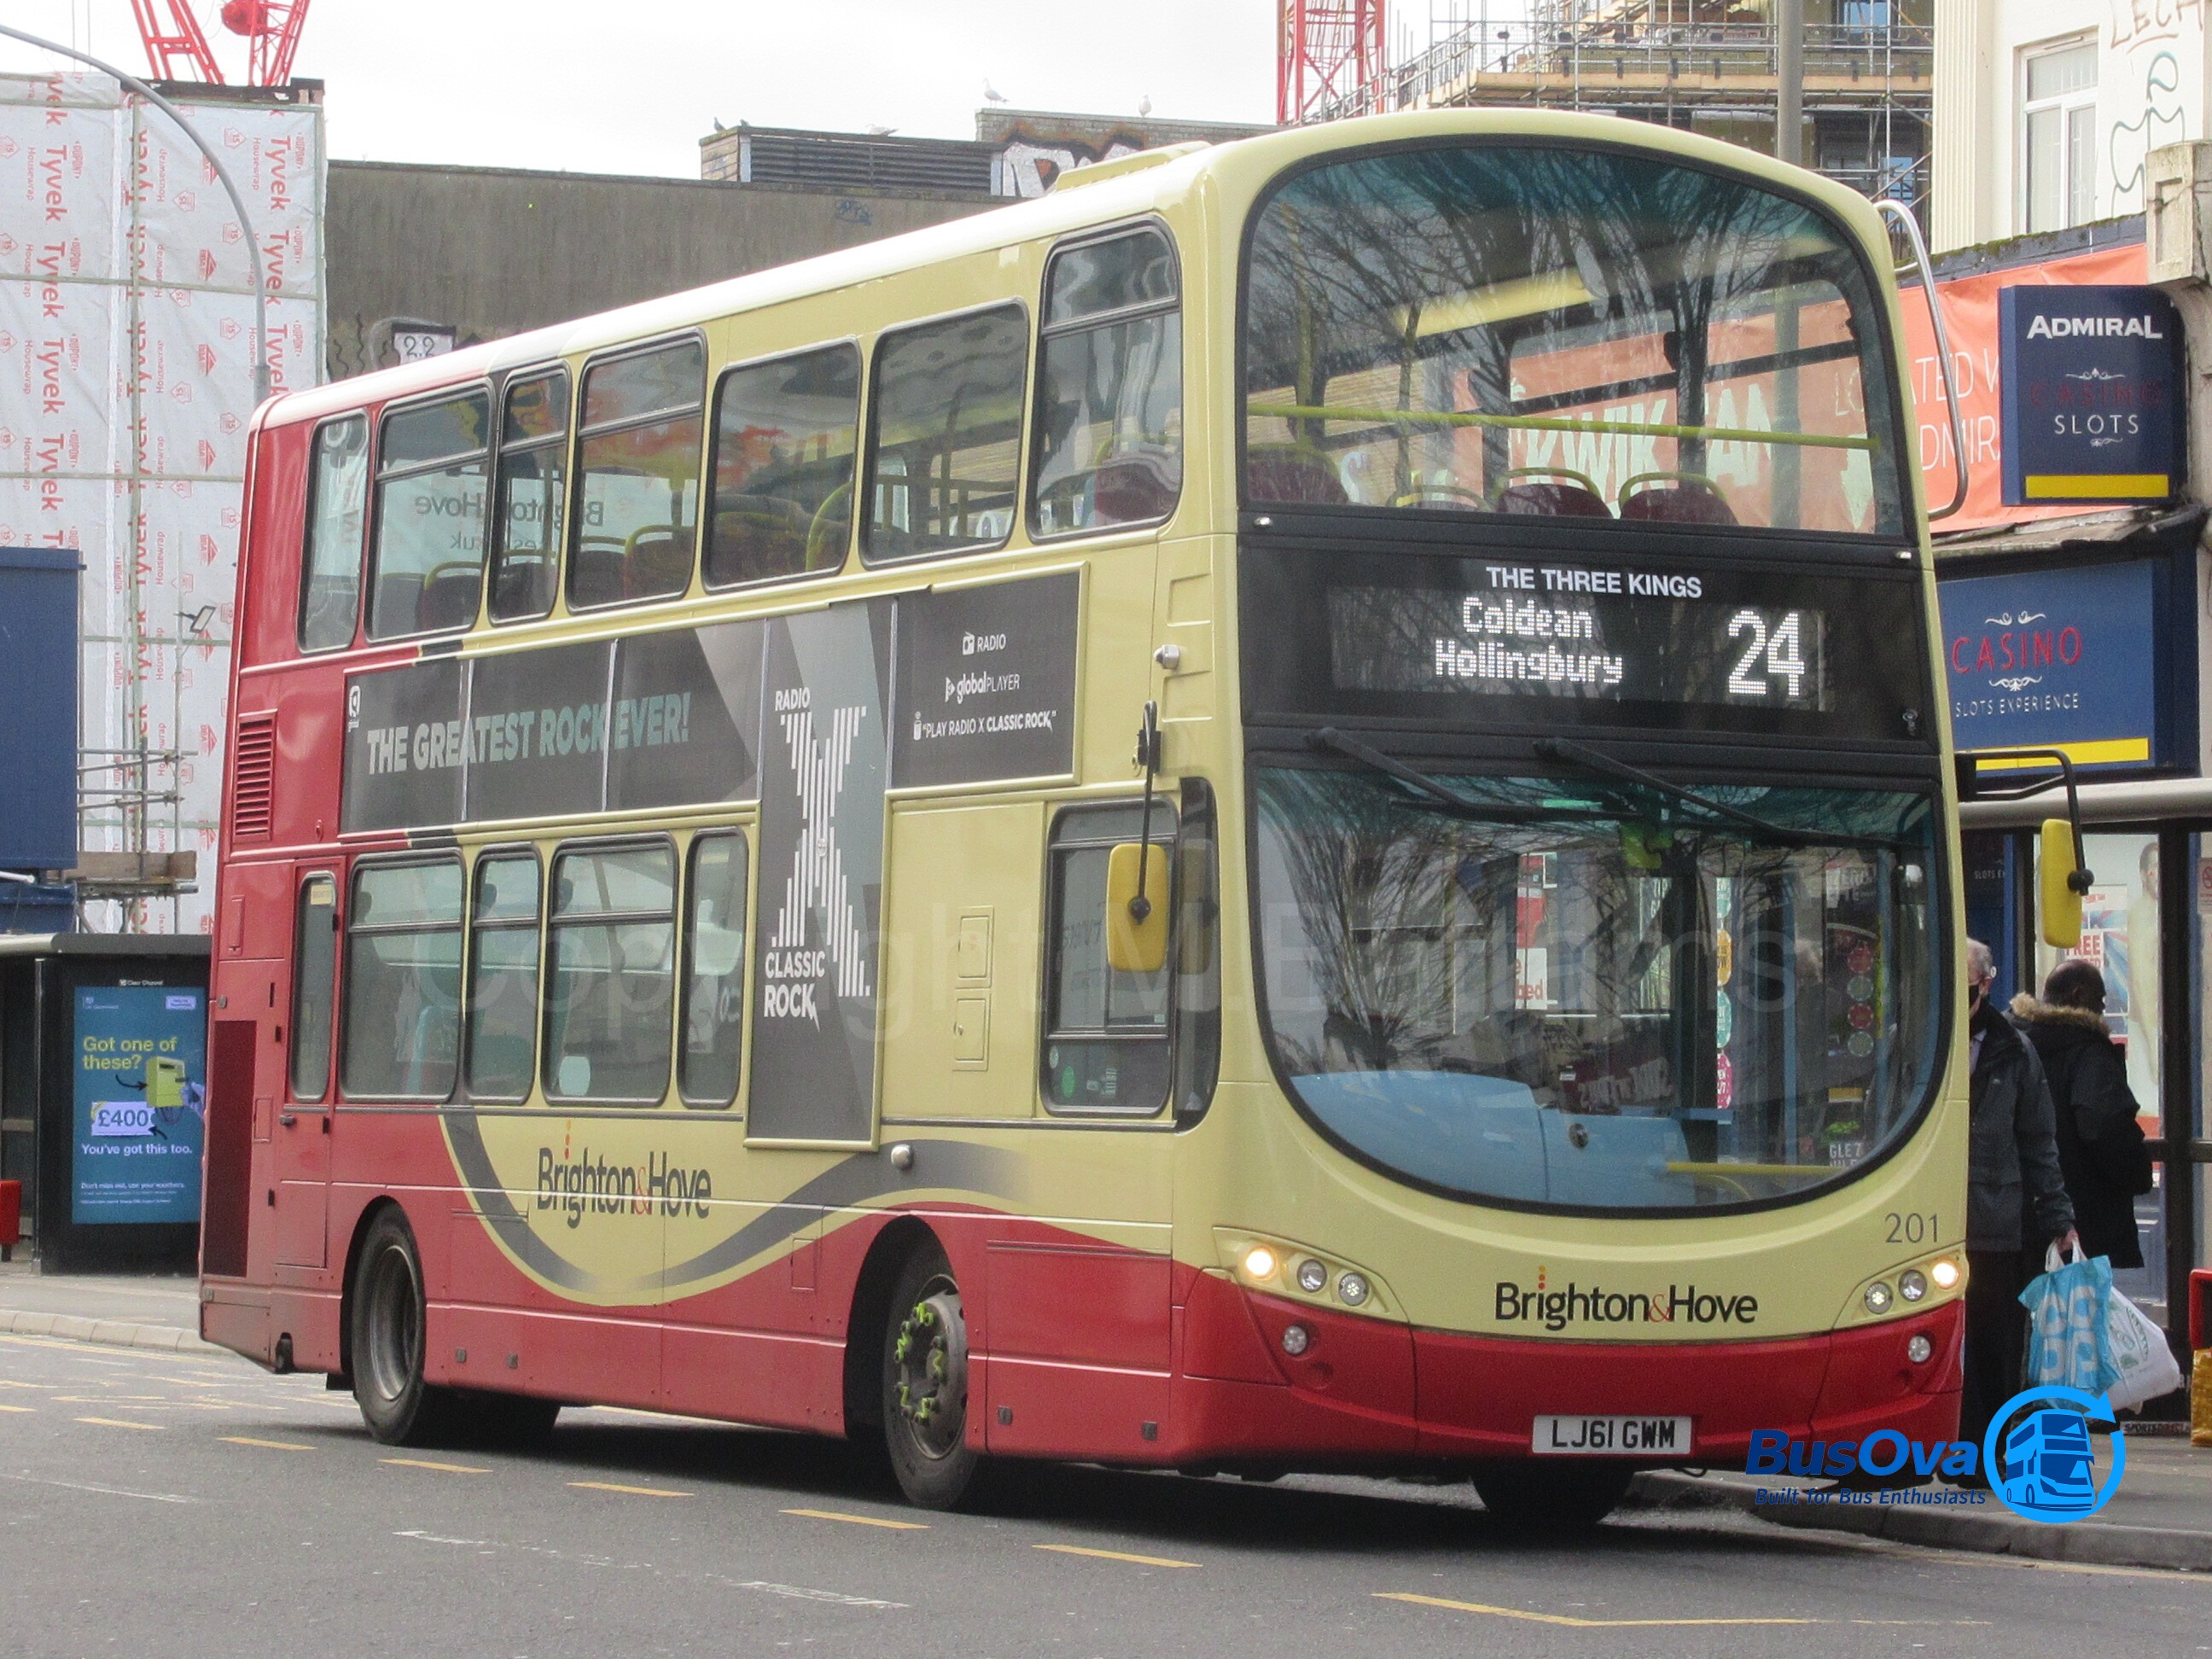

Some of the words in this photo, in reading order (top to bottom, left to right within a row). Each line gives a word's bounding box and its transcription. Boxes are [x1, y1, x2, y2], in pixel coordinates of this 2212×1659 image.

[26, 147, 36, 201] Housewrap
[252, 137, 261, 190] Housewrap
[265, 136, 292, 212] Tyvek
[40, 145, 68, 222] Tyvek
[2026, 315, 2163, 340] ADMIRAL
[23, 340, 33, 395] Housewrap
[37, 337, 66, 414] Tyvek
[2029, 384, 2163, 408] CASINO
[2054, 415, 2139, 435] SLOTS
[155, 531, 166, 586] Housewrap
[1486, 566, 1535, 590] THE
[1541, 569, 1621, 594] THREE
[1628, 573, 1703, 598] KINGS
[1462, 597, 1592, 638] Coldean
[976, 633, 1006, 653] RADIO
[1728, 610, 1805, 696] 24
[1952, 627, 2082, 673] CASINO
[1435, 639, 1622, 685] Hollingbury
[775, 687, 811, 713] RADIO
[1955, 698, 1994, 718] SLOTS
[2000, 692, 2080, 714] EXPERIENCE
[367, 726, 408, 775] THE
[413, 711, 535, 771] GREATEST
[539, 705, 609, 757] ROCK
[614, 691, 692, 749] EVER!
[949, 718, 976, 736] RADIO
[978, 717, 985, 733] X
[986, 713, 1024, 732] CLASSIC
[765, 951, 825, 980] CLASSIC
[764, 983, 820, 1028] ROCK
[83, 1036, 115, 1052] Got
[120, 1039, 154, 1052] one
[160, 1036, 178, 1052] of
[83, 1054, 142, 1070] these?
[97, 1109, 149, 1127] £400
[81, 1144, 119, 1155] You've
[124, 1145, 143, 1157] got
[146, 1144, 167, 1154] this
[171, 1144, 193, 1155] too.
[1885, 1213, 1940, 1243] 201
[1551, 1420, 1614, 1449] LJ61
[1622, 1419, 1675, 1448] GWM
